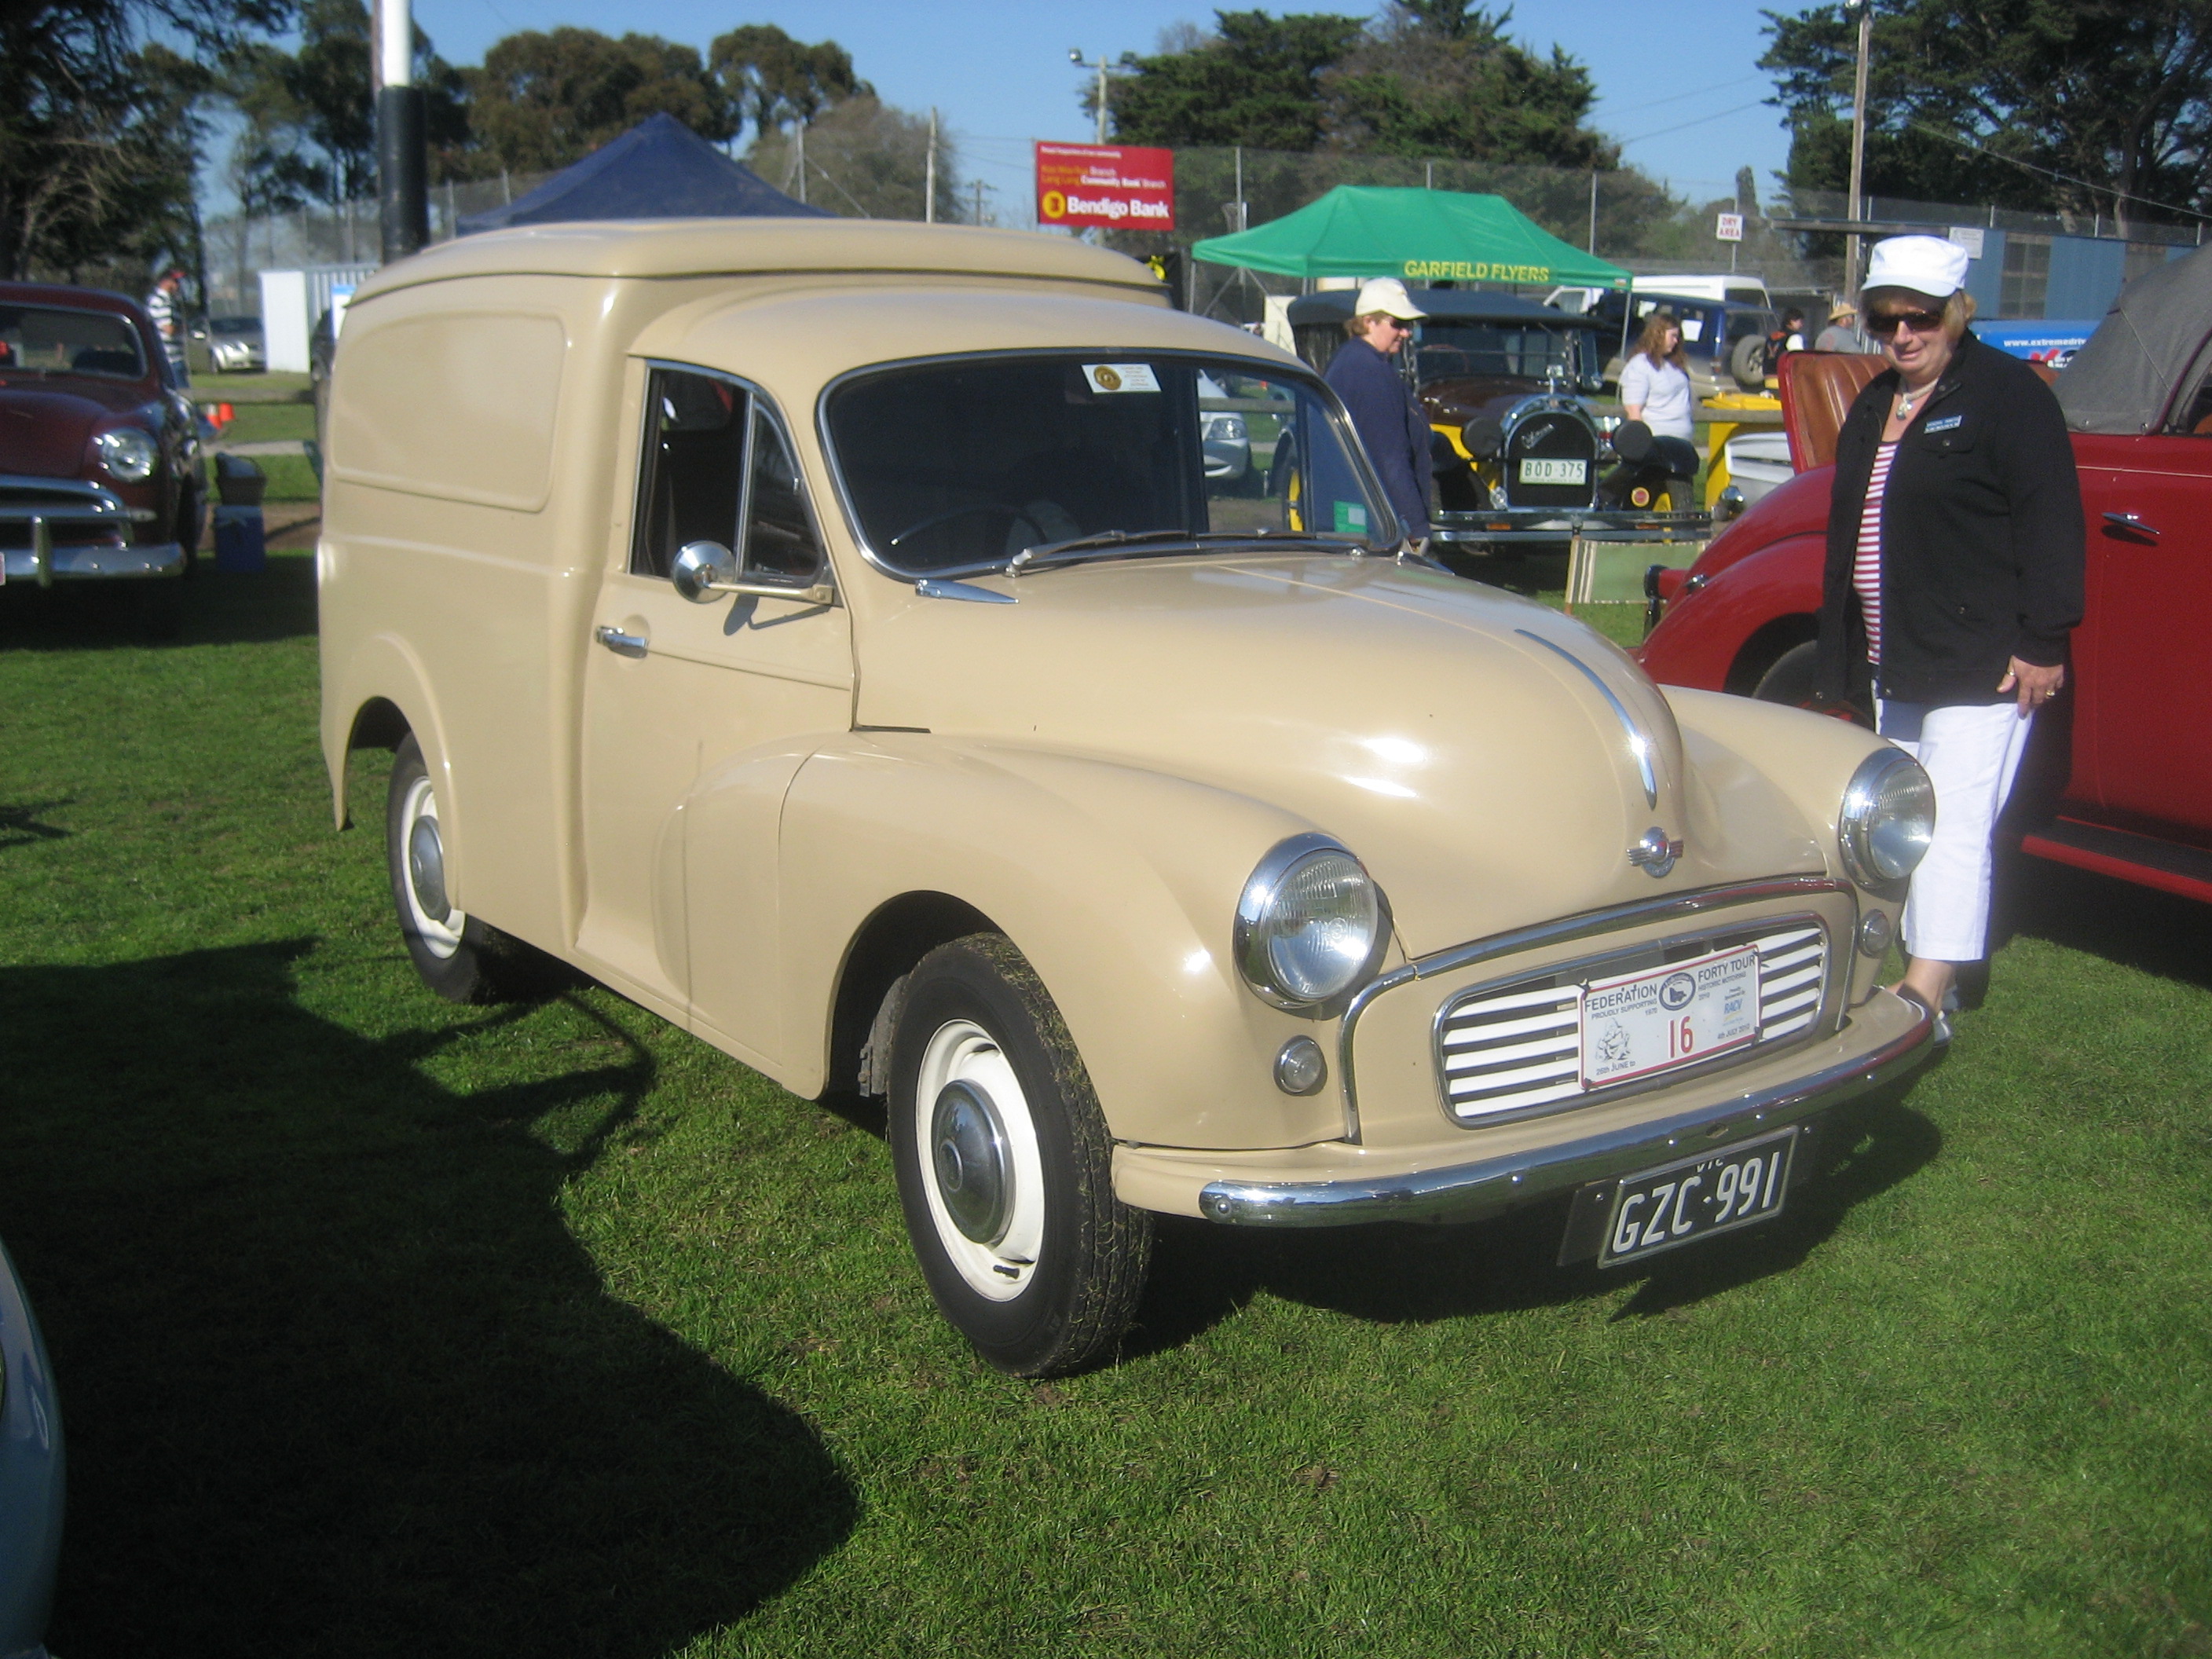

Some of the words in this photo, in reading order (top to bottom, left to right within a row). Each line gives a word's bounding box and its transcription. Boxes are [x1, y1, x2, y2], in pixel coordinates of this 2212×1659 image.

[1067, 196, 1128, 218] Bendigo
[1130, 199, 1170, 218] Bank
[1719, 228, 1739, 236] AREA
[1404, 260, 1488, 279] GARFIELD
[1492, 263, 1549, 282] FLYERS
[1698, 963, 1727, 982] FORTY
[1730, 955, 1755, 972] TOUR
[1584, 983, 1657, 1012] FEDERATION
[1723, 999, 1743, 1014] RACV
[1591, 1008, 1619, 1020] PROUDLY
[1621, 998, 1657, 1013] SUPPORTING
[1669, 1016, 1694, 1058] 16
